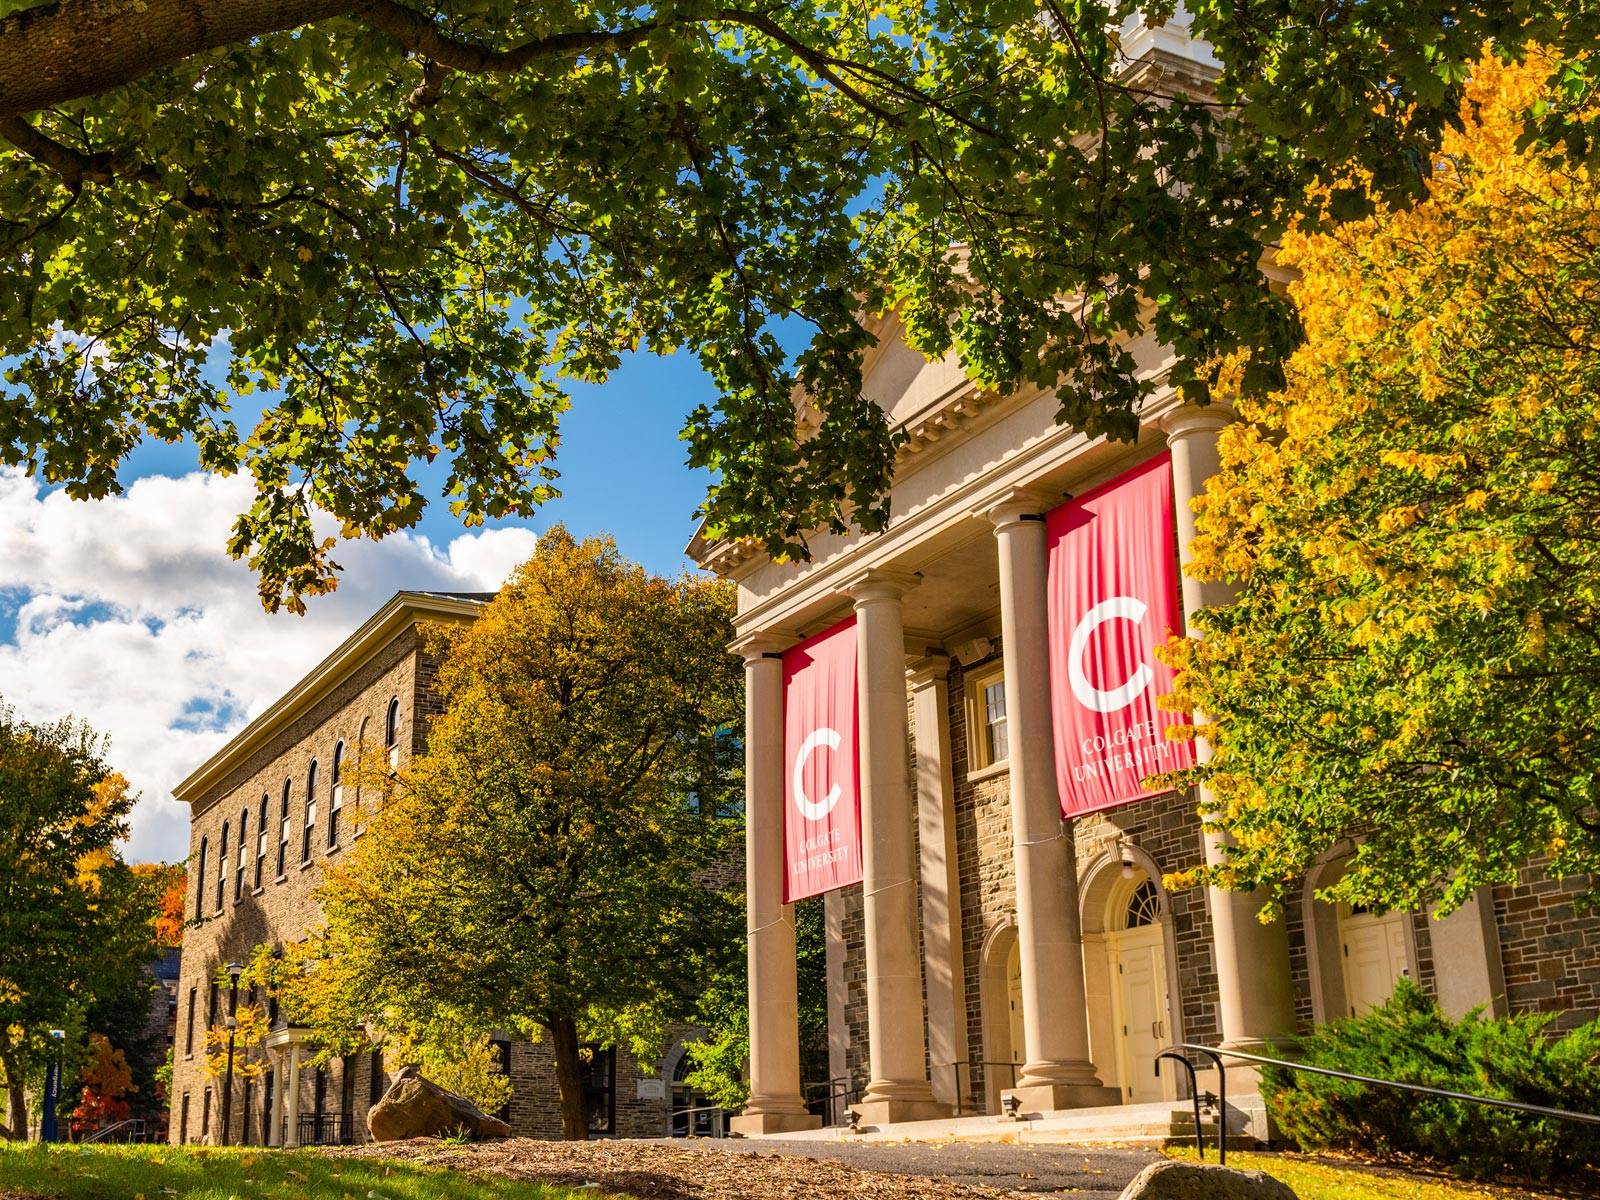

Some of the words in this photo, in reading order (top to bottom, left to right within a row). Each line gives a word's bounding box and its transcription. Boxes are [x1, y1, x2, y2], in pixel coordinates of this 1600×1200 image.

[1068, 596, 1153, 713] C
[1082, 721, 1155, 755] COLGATE
[794, 728, 841, 821] C
[1074, 741, 1170, 782] UNIVERSITY
[799, 828, 841, 854] COLGATE
[792, 845, 849, 876] UNIVERSITY
